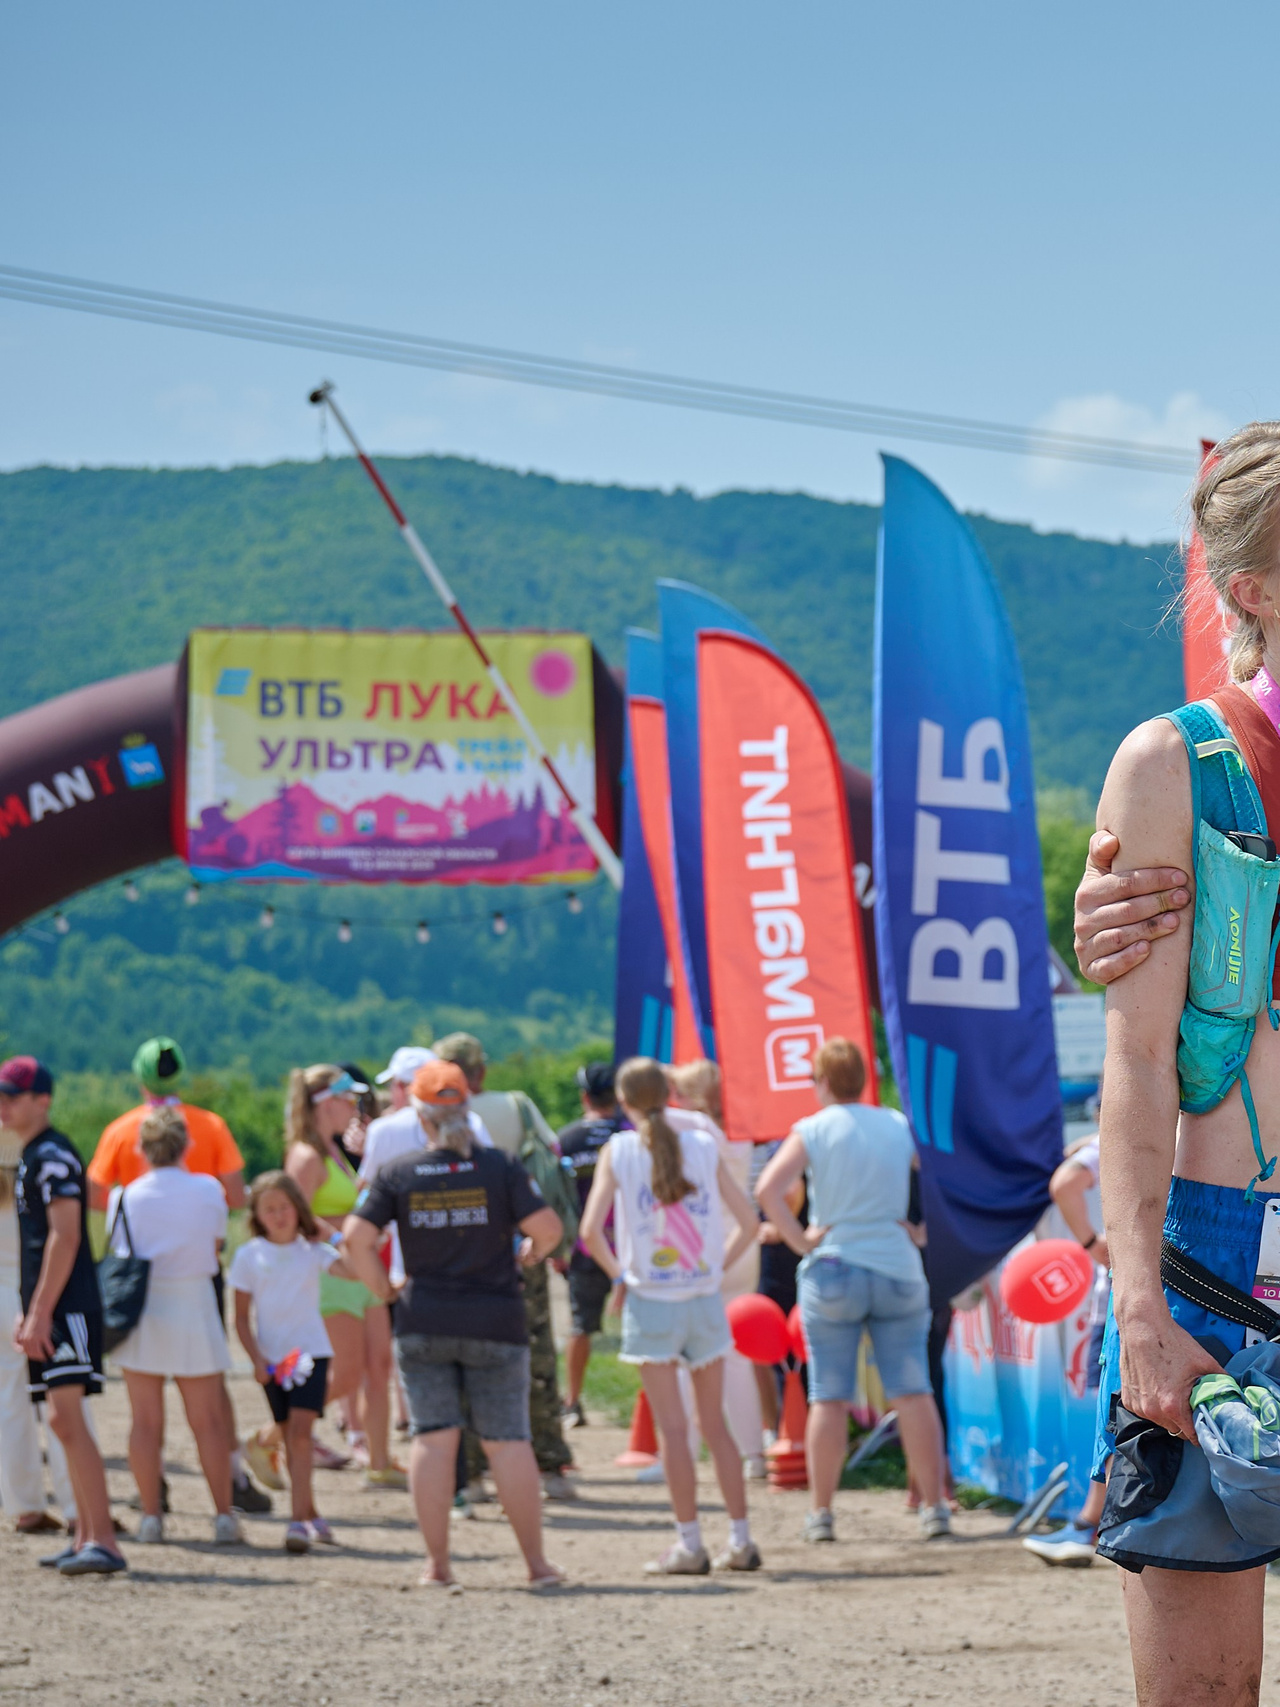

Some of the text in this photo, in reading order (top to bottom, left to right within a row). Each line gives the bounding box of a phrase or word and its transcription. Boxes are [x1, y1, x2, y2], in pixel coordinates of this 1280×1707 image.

[258, 680, 514, 720] ВТБ ЛУКА
[257, 738, 446, 773] УЛЬТРА
[907, 716, 1021, 1010] ВТБ
[1229, 906, 1241, 985] AONIJIE
[1263, 1289, 1277, 1298] 10
